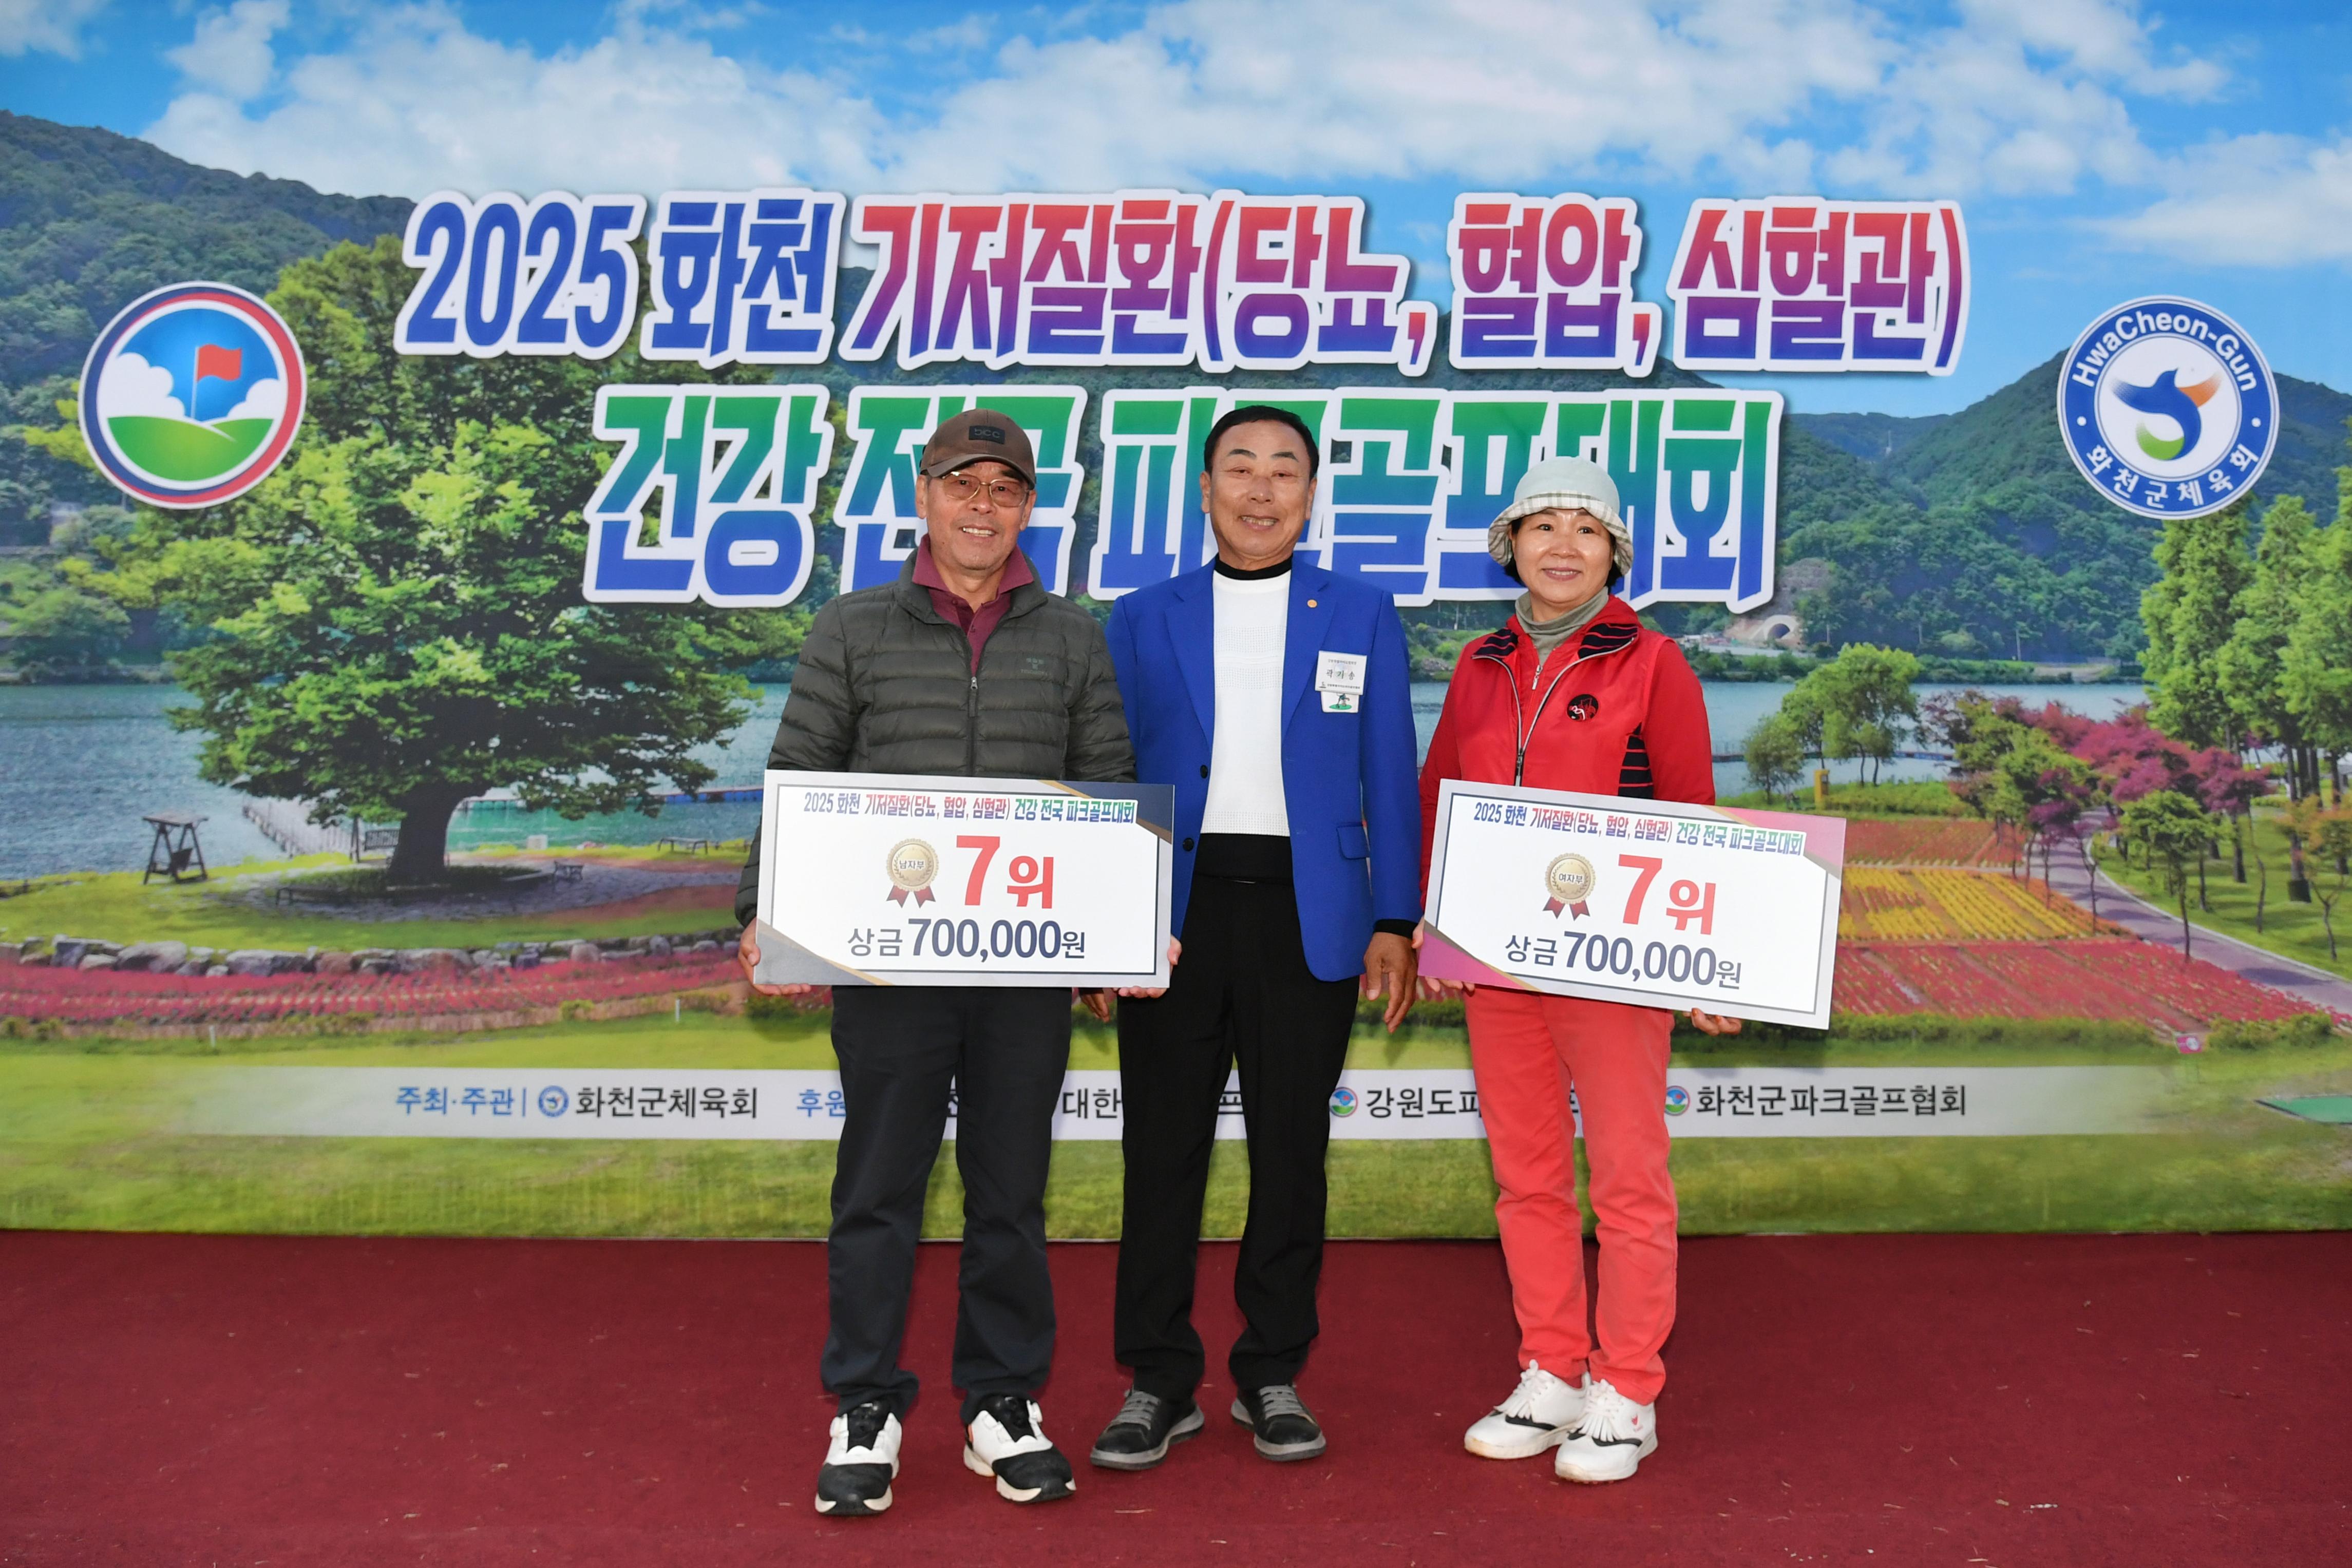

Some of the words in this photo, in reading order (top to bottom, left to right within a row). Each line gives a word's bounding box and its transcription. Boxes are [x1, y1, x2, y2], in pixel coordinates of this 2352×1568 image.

[406, 201, 635, 349] 2025
[651, 198, 834, 355] 화천
[851, 199, 1427, 365] 기저질환(당뇨,
[1458, 203, 1651, 366] 혈압,
[1679, 206, 1963, 368] 심혈관)
[2072, 311, 2257, 392] HwaCheon-Gun
[596, 395, 823, 596] 건강
[2086, 444, 2259, 509] 화천군체육회
[804, 792, 834, 813] 2025
[837, 793, 861, 814] 화천
[864, 794, 939, 820] 기저질환(당뇨,
[944, 796, 969, 821] 혈압,
[973, 798, 1011, 820] 심혈관)
[1015, 798, 1037, 820] 건강
[1041, 799, 1064, 821] 전국
[1066, 800, 1135, 824] 파크골프대회
[1474, 802, 1503, 823] 2025
[1504, 805, 1527, 826] 화천
[1530, 808, 1602, 837] 기저질환(당뇨,
[1606, 815, 1630, 840] 혈압,
[1634, 818, 1673, 843] 심혈관)
[1676, 822, 1701, 845] 건강
[1703, 825, 1728, 848] 전국
[1729, 827, 1804, 855] 파크골프대회
[899, 860, 924, 869] 남자부
[1559, 873, 1583, 884] 여자부
[576, 1086, 757, 1118] 화천군체육회
[1696, 1084, 1966, 1117] 화천군파크골프협회
